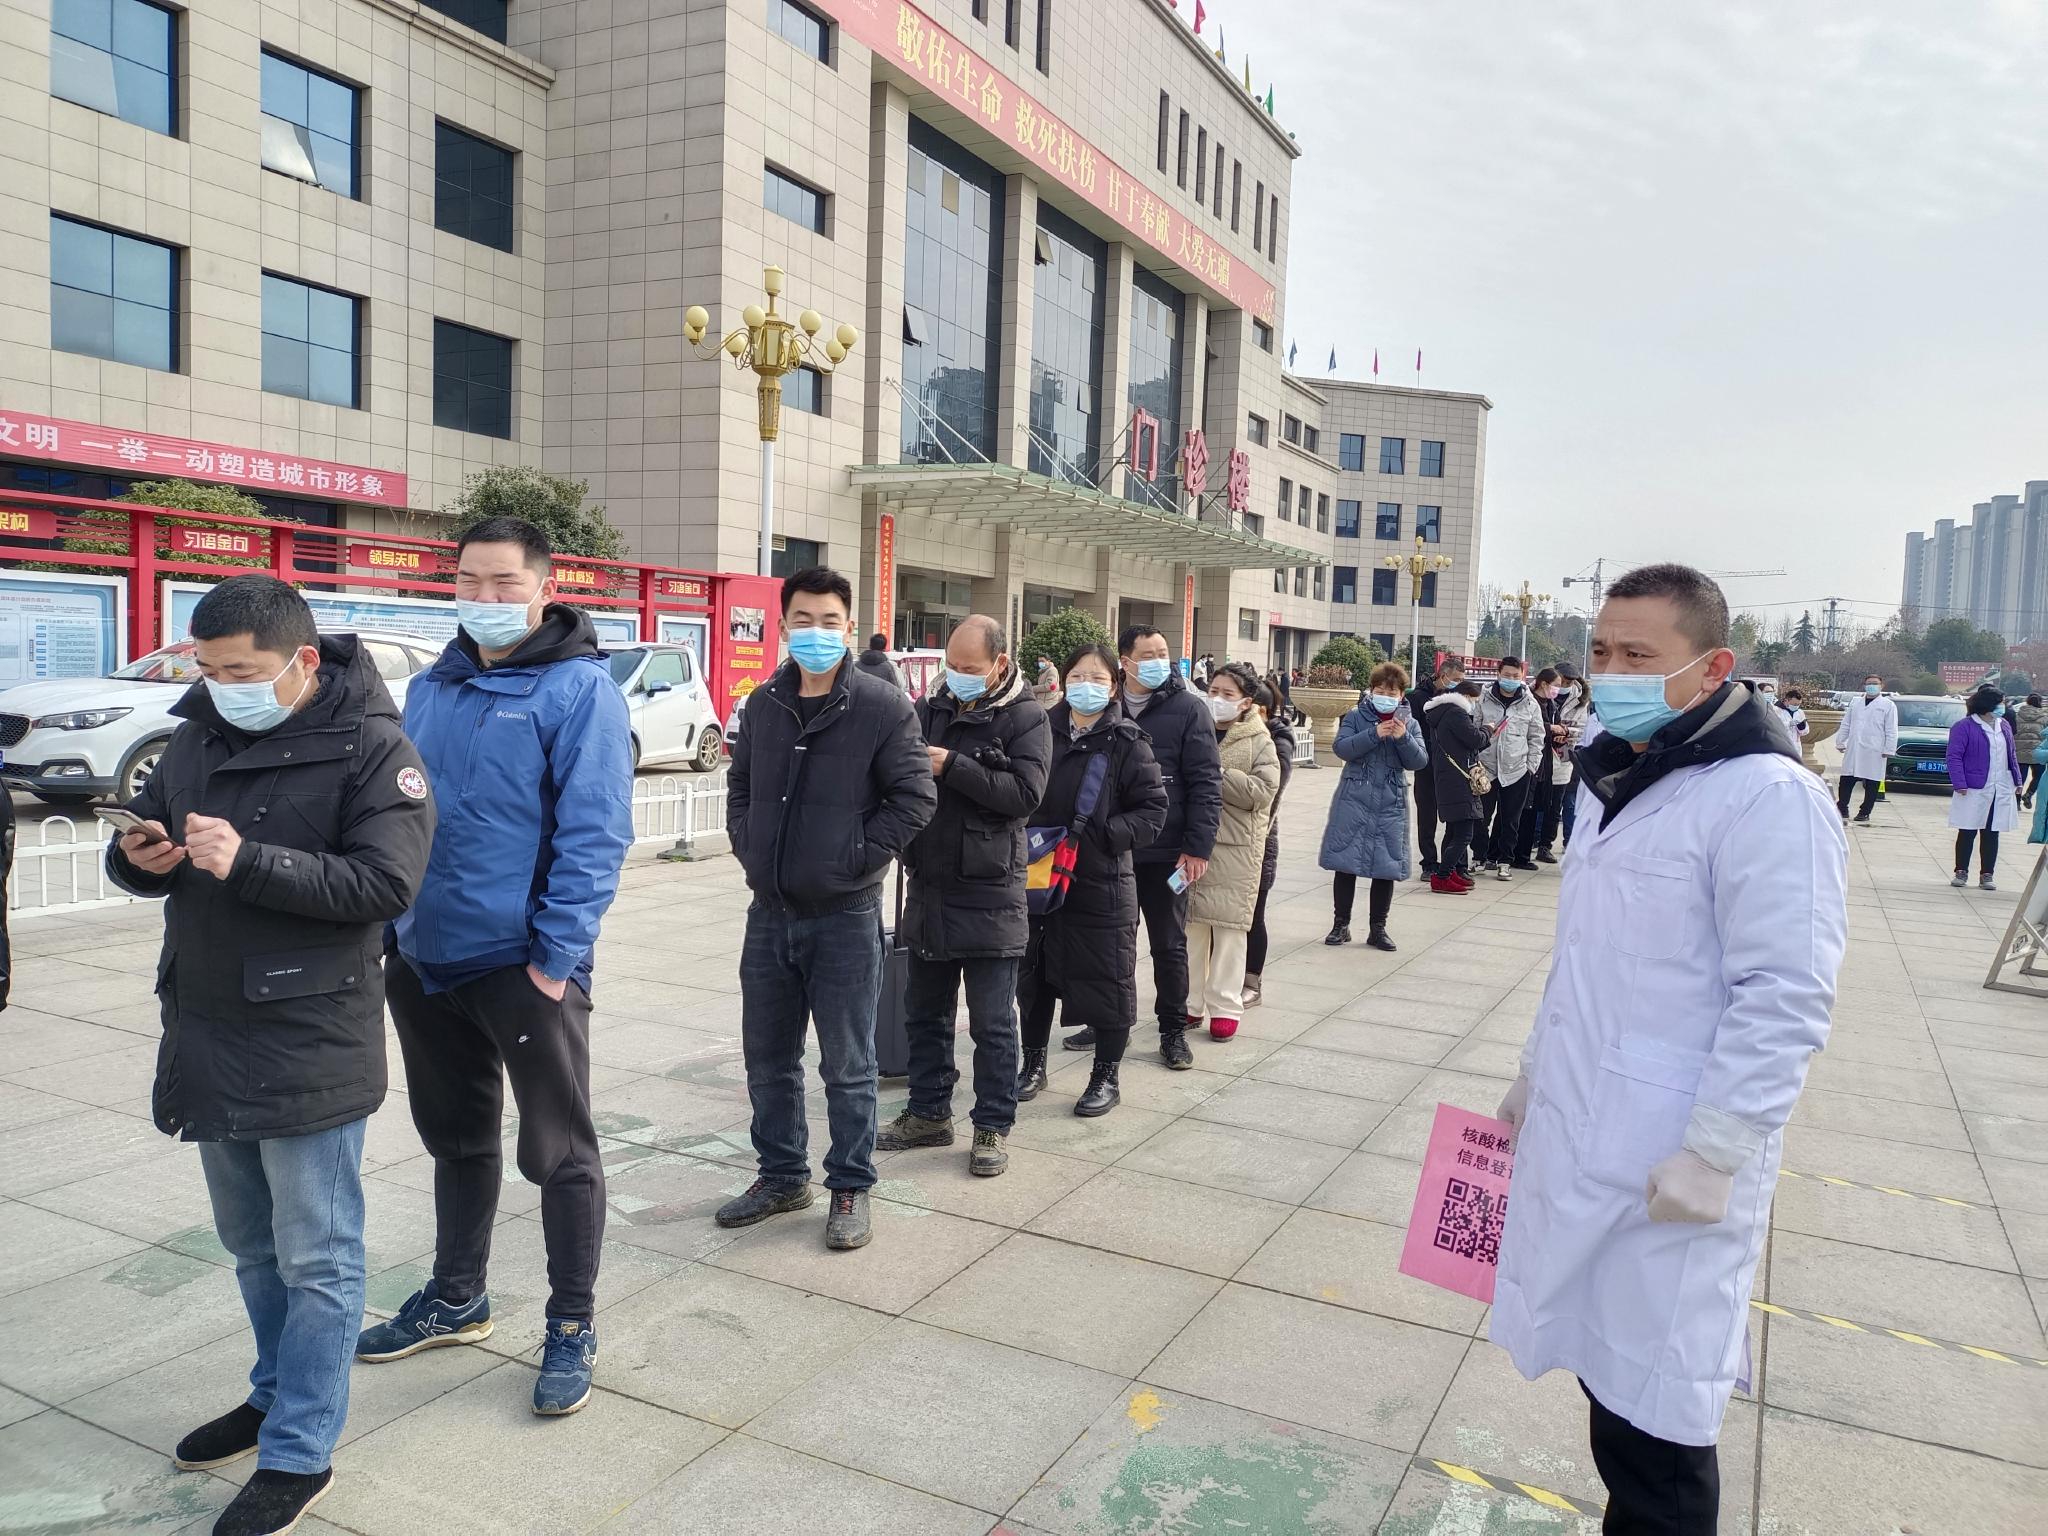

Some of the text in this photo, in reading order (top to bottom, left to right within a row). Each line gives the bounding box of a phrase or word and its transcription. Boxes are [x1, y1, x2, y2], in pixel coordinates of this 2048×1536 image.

[896, 3, 1230, 290] 敬佑生命 救死扶伤 甘于奉献 大爱无疆
[80, 438, 384, 497] 一举一动塑造城市形象
[1131, 407, 1250, 514] 门诊楼
[184, 531, 249, 553] 习语金句
[556, 568, 595, 585] 基本概况
[1461, 1126, 1516, 1156] 核酸检
